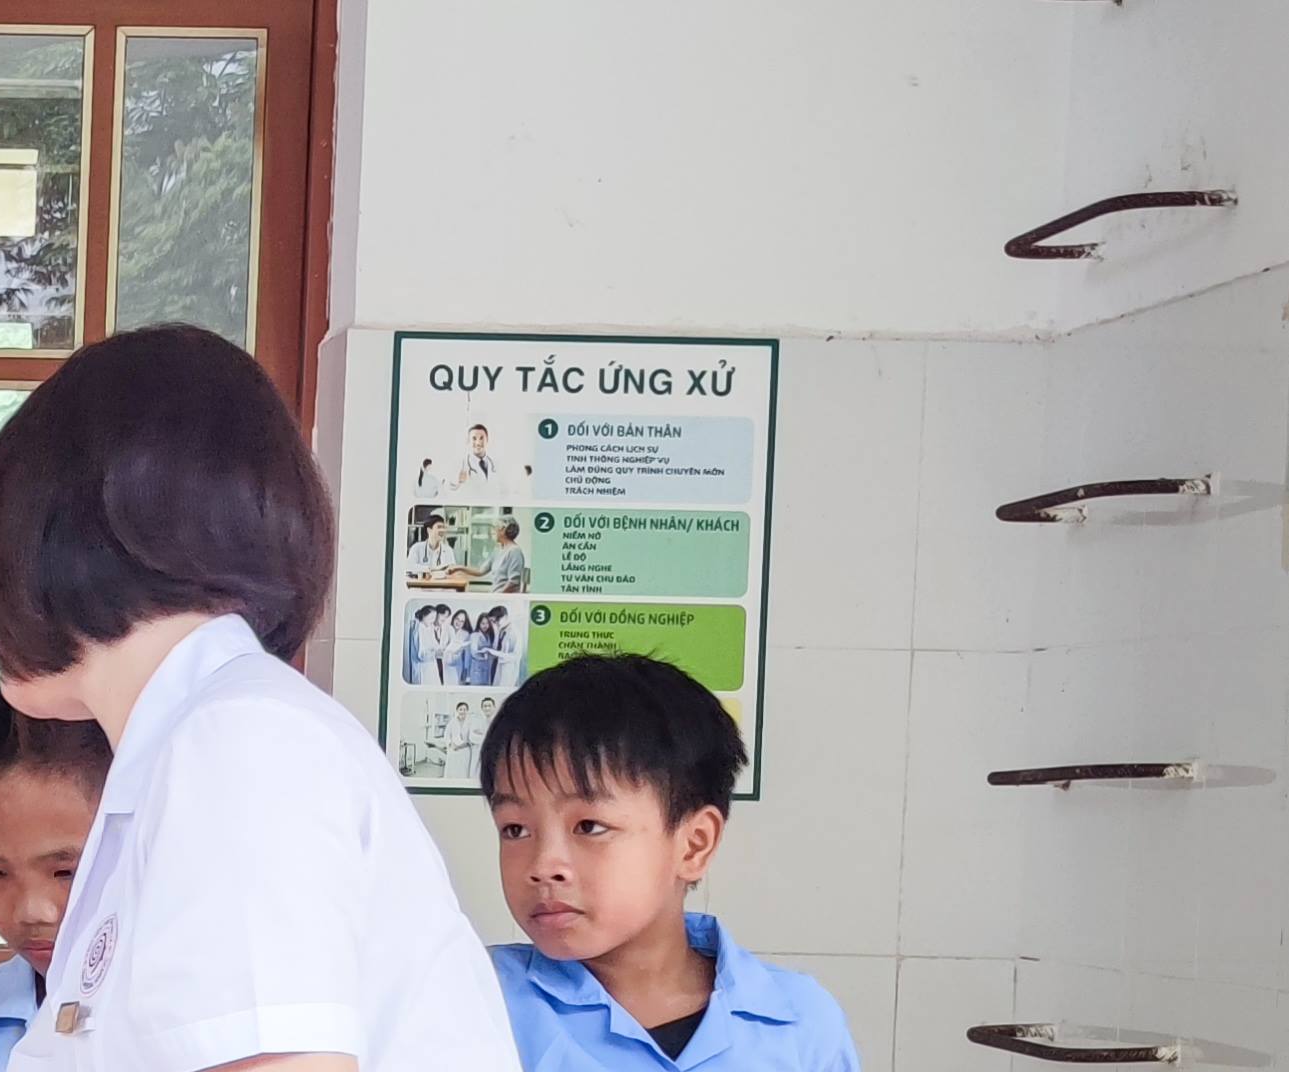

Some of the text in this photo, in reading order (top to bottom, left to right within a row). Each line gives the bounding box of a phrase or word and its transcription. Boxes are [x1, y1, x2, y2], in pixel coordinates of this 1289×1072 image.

[429, 354, 736, 397] QUY TẮC ỨNG XỬ
[568, 420, 589, 436] ĐỐI
[593, 422, 613, 436] VỚI
[617, 422, 644, 437] BẢN
[647, 423, 682, 438] THÂN
[600, 444, 624, 453] CÁCH
[589, 455, 620, 463] THÔNG
[565, 465, 585, 473] LÀM
[587, 465, 613, 474] ĐÚNG
[665, 467, 701, 475] CHUYÊN
[565, 486, 594, 495] TRÁCH
[564, 512, 585, 529] ĐỐI
[589, 514, 610, 529] VỚI
[613, 515, 647, 532] BỆNH
[696, 517, 740, 532] KHÁCH
[560, 608, 581, 623] ĐỐI
[585, 609, 606, 624] VỚI
[610, 608, 645, 625] ĐỒNG
[648, 611, 694, 628] NGHIỆP
[560, 631, 590, 639] TRUNG
